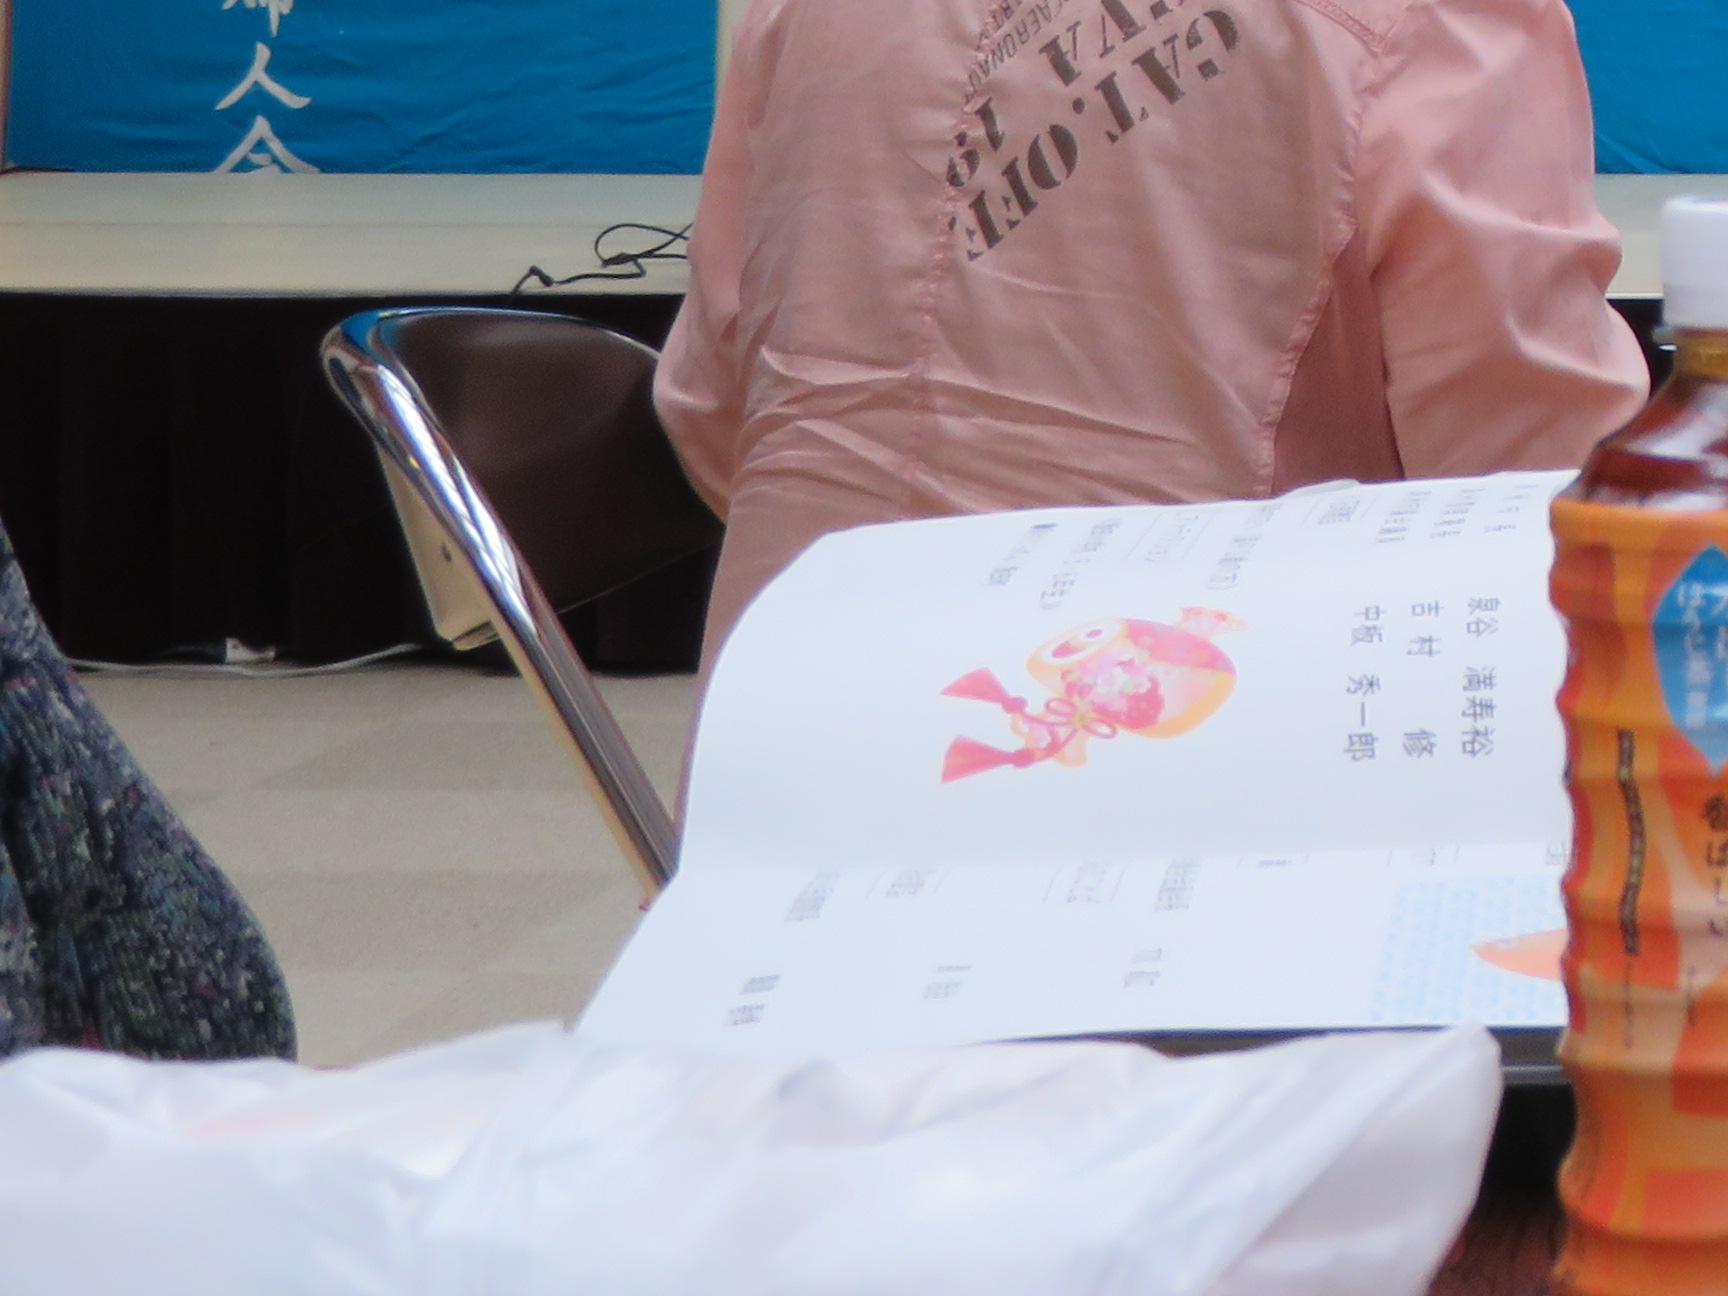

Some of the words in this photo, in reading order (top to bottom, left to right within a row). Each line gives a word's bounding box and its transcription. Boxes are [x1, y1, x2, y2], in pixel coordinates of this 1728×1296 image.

[1406, 599, 1444, 659] 吉村
[1342, 673, 1382, 763] 秀一郎
[1401, 727, 1438, 760] 修
[1461, 666, 1498, 760] 満寿裕
